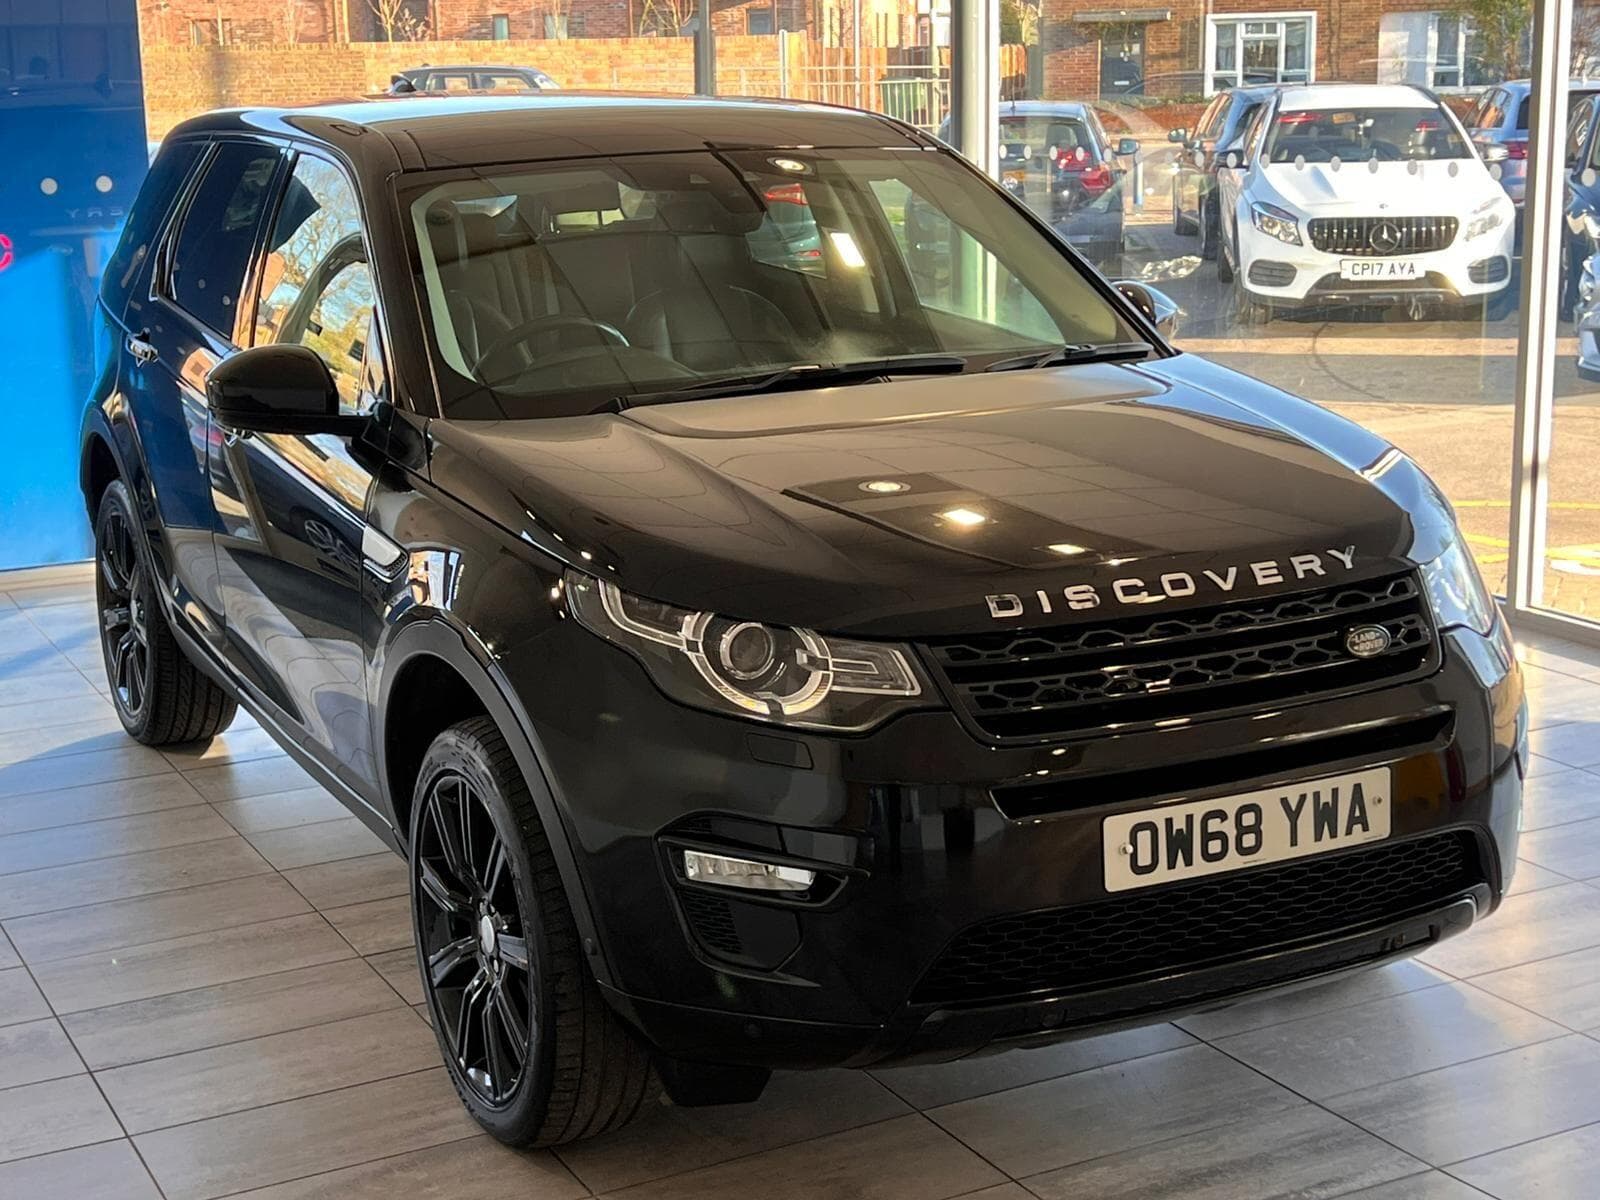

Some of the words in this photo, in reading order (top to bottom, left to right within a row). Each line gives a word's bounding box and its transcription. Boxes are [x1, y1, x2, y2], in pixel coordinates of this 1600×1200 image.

[1351, 262, 1384, 276] CP17
[1388, 262, 1416, 275] AYA
[984, 544, 1357, 619] DISCOVERY
[1128, 802, 1264, 876] OW68
[1279, 782, 1370, 848] YWA
